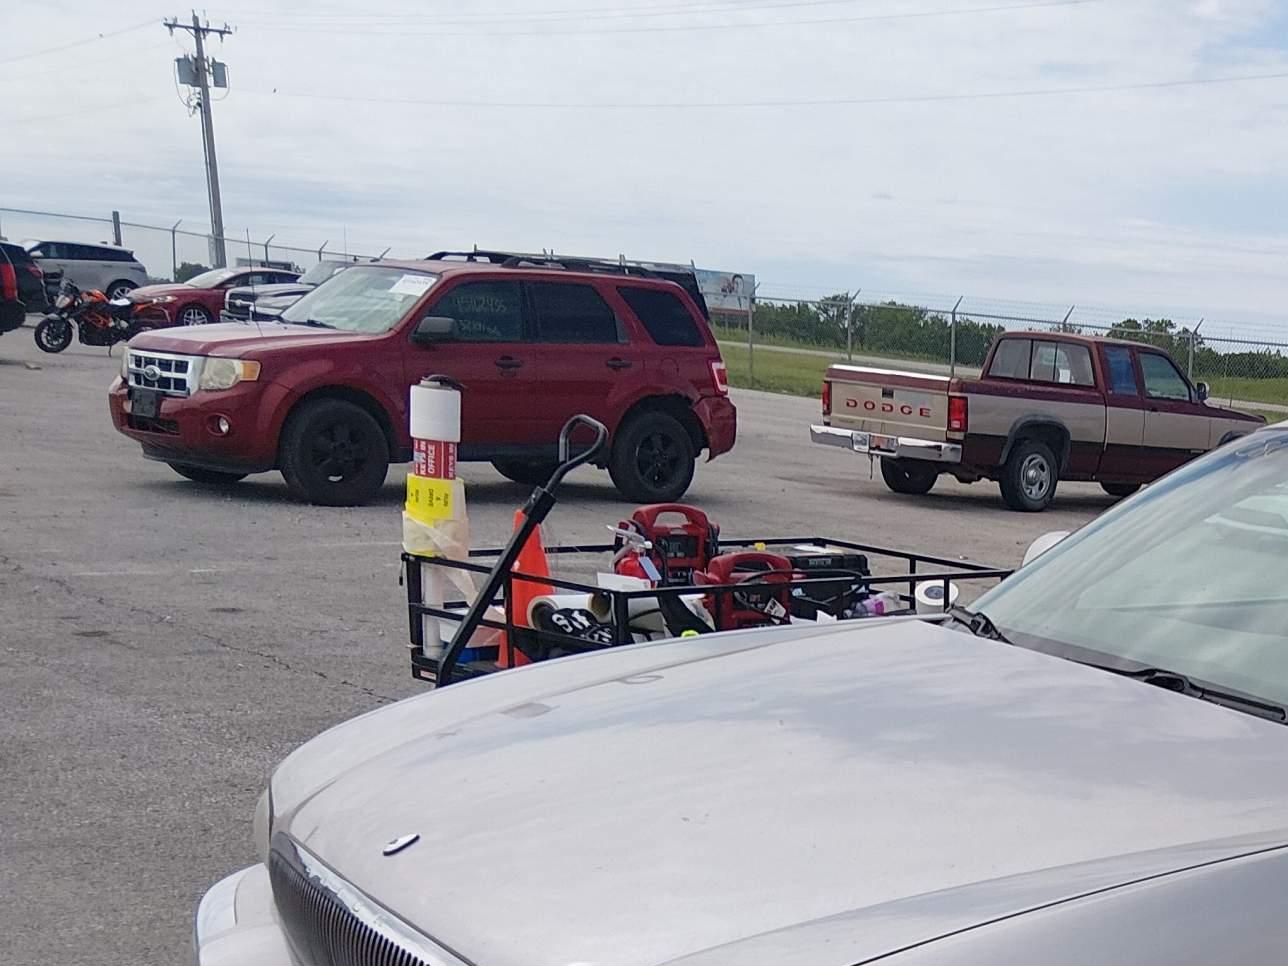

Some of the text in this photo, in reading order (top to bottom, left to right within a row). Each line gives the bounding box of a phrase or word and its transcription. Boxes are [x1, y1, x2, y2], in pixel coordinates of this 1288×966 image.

[846, 398, 932, 418] DODGE
[427, 443, 436, 475] OFFICE
[427, 488, 435, 508] DRIVE
